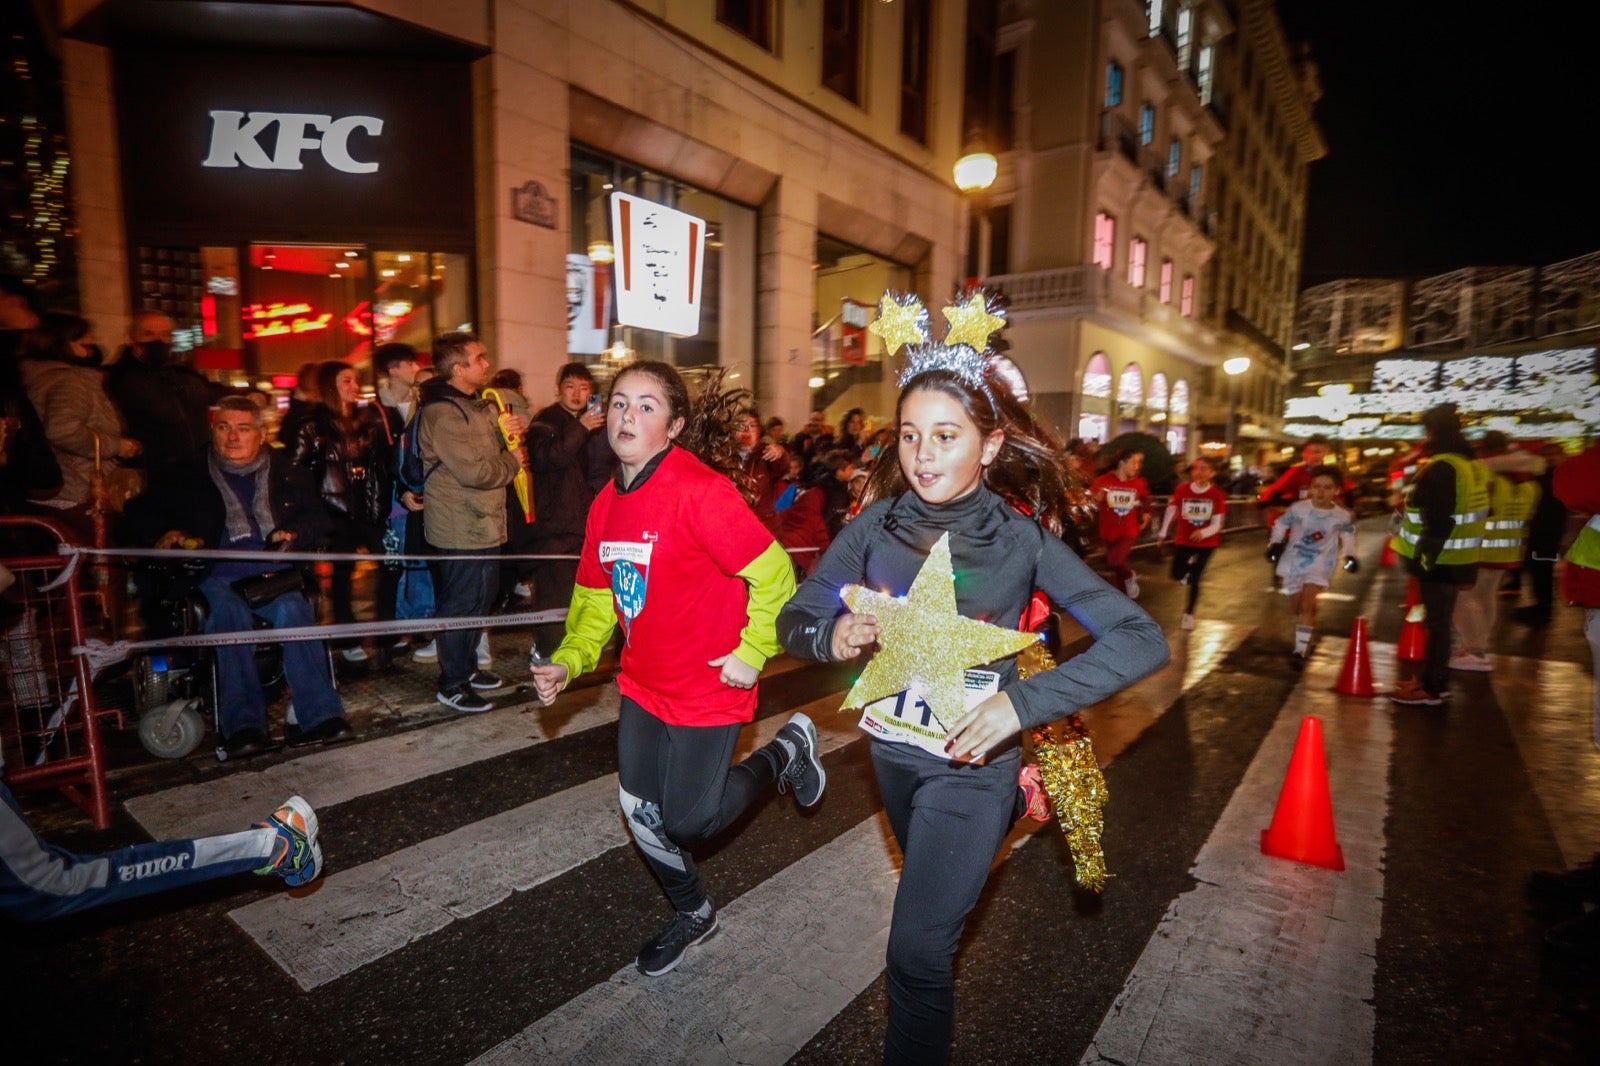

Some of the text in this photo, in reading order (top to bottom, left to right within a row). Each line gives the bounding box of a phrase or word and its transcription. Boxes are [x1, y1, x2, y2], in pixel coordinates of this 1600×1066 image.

[202, 109, 384, 174] KFC
[1188, 505, 1207, 514] 284
[602, 546, 610, 557] 30
